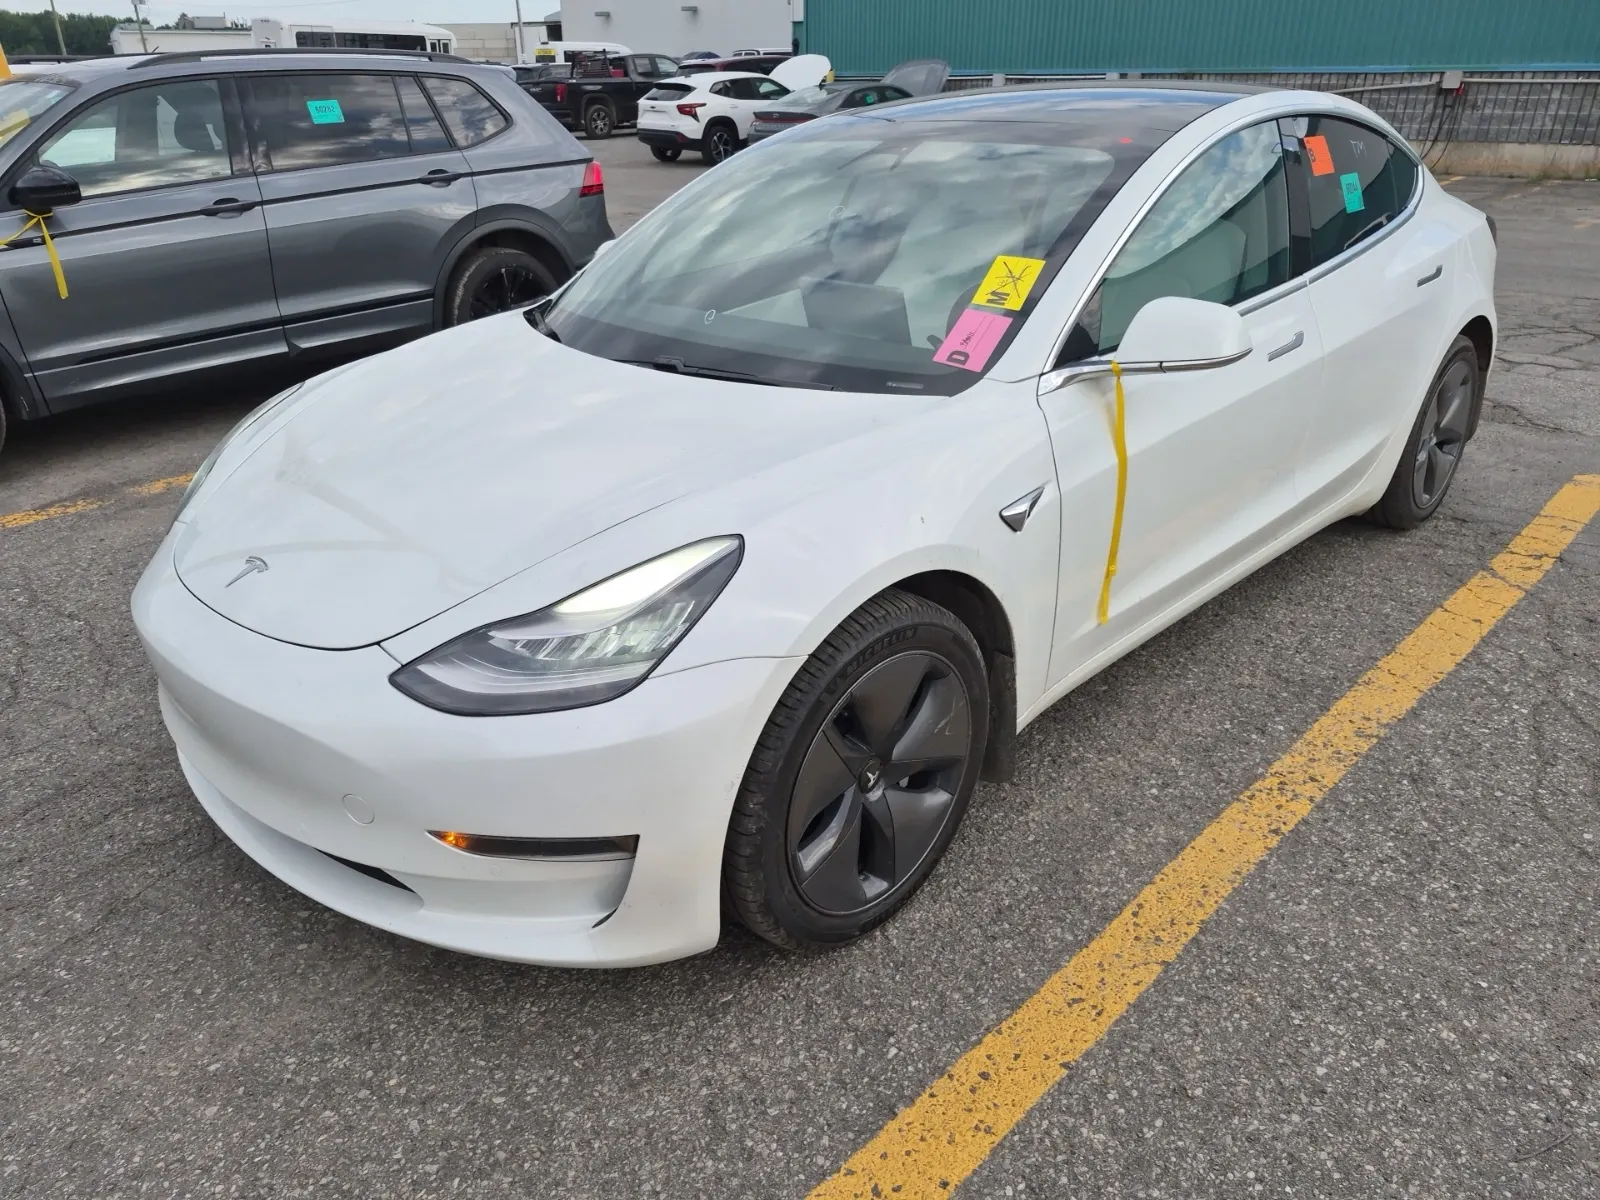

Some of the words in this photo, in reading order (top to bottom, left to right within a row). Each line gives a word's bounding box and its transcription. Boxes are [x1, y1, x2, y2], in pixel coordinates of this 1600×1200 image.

[986, 291, 1011, 306] M
[946, 350, 970, 366] D
[845, 626, 917, 677] MICHELIN
